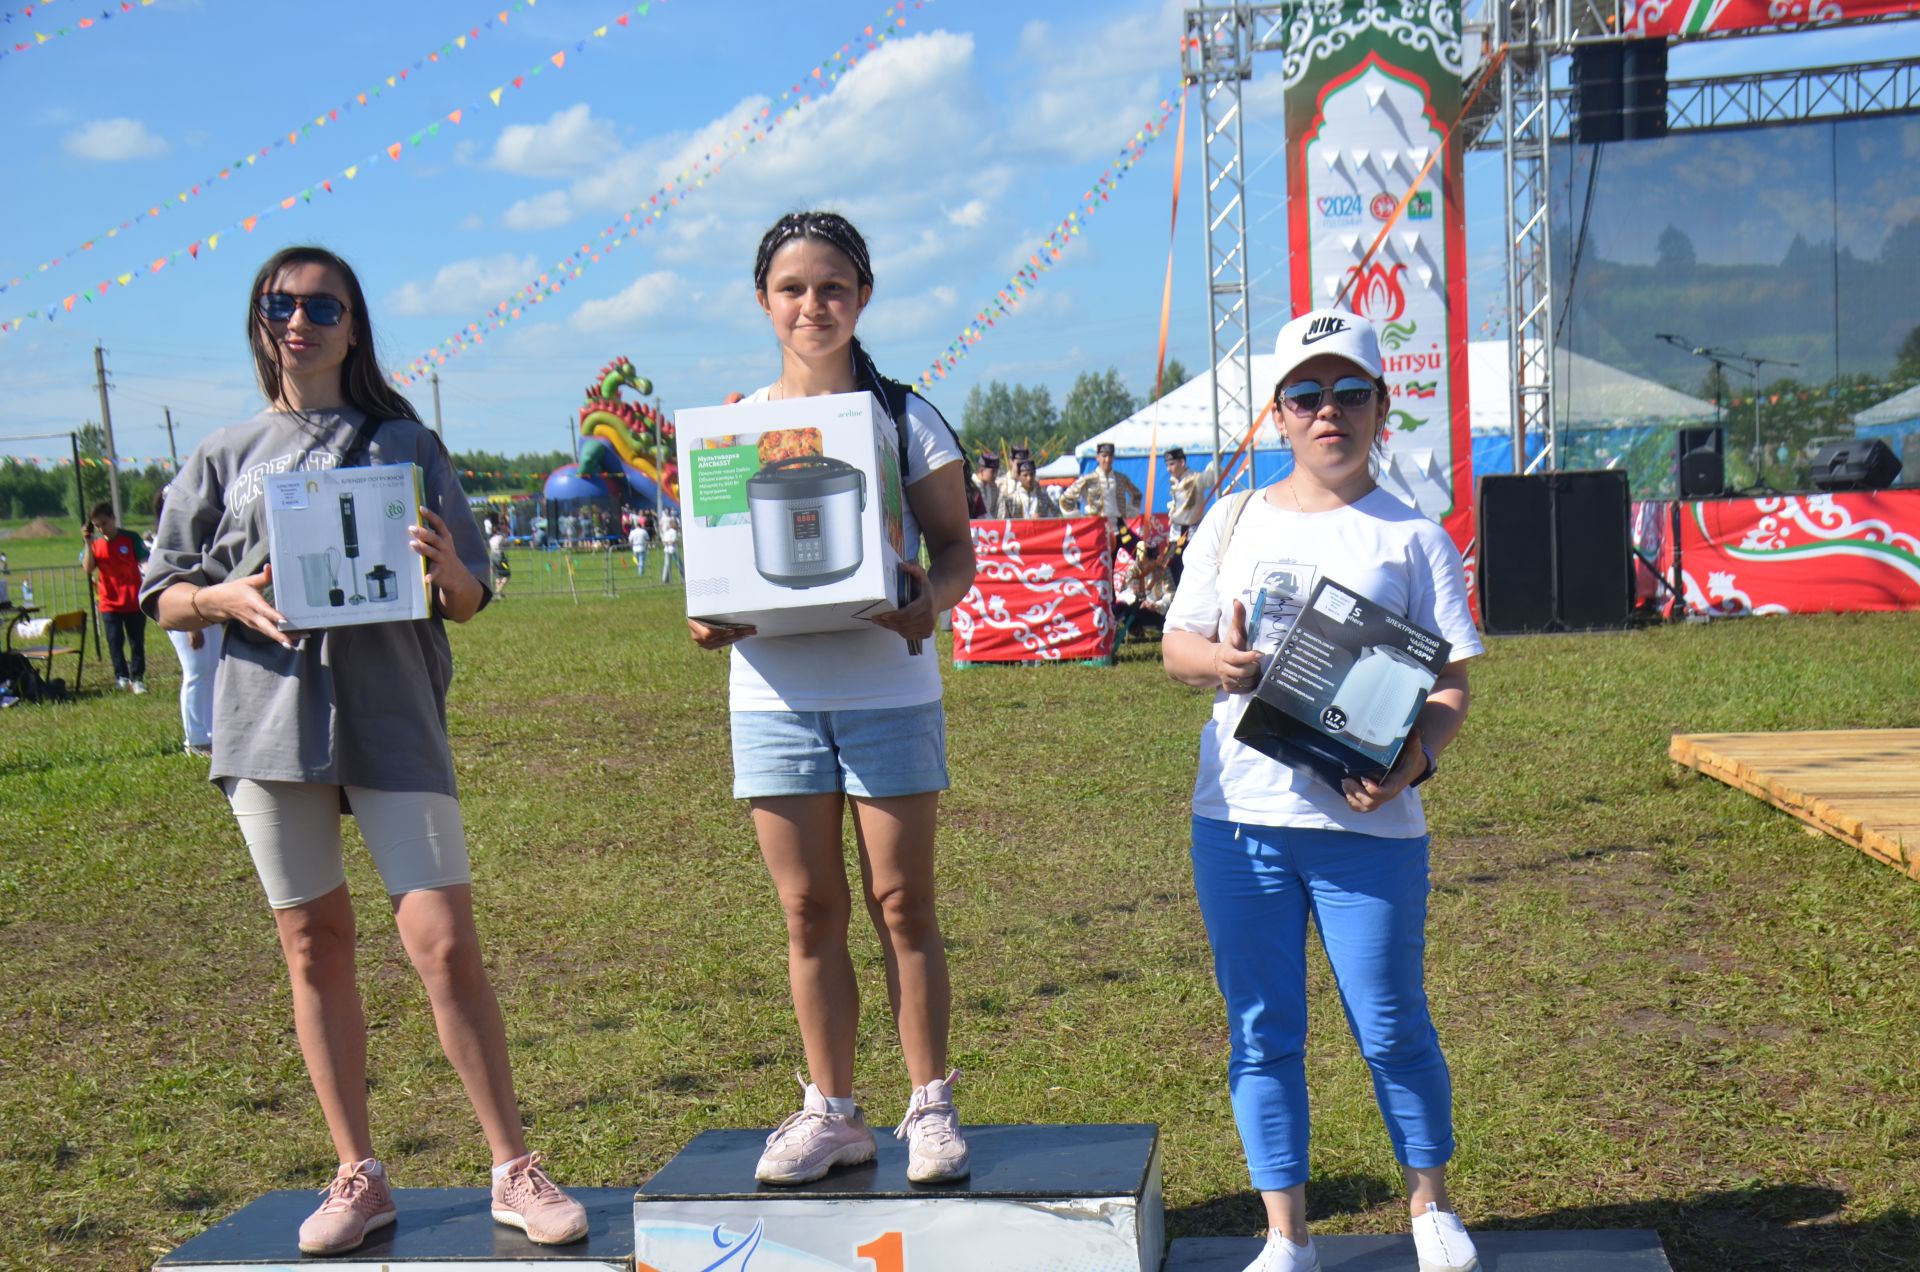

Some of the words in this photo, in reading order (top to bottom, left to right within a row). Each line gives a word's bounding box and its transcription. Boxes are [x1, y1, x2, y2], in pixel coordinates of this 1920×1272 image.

[1323, 195, 1361, 217] 2024
[1308, 317, 1345, 335] NIKE
[838, 409, 863, 418] aceline
[698, 453, 740, 463] Мультиварка
[1385, 616, 1440, 648] ЭЛЕКТРИЧЕСКИЙ
[1409, 637, 1437, 655] ЧАЙНИК
[857, 1231, 903, 1272] 1
